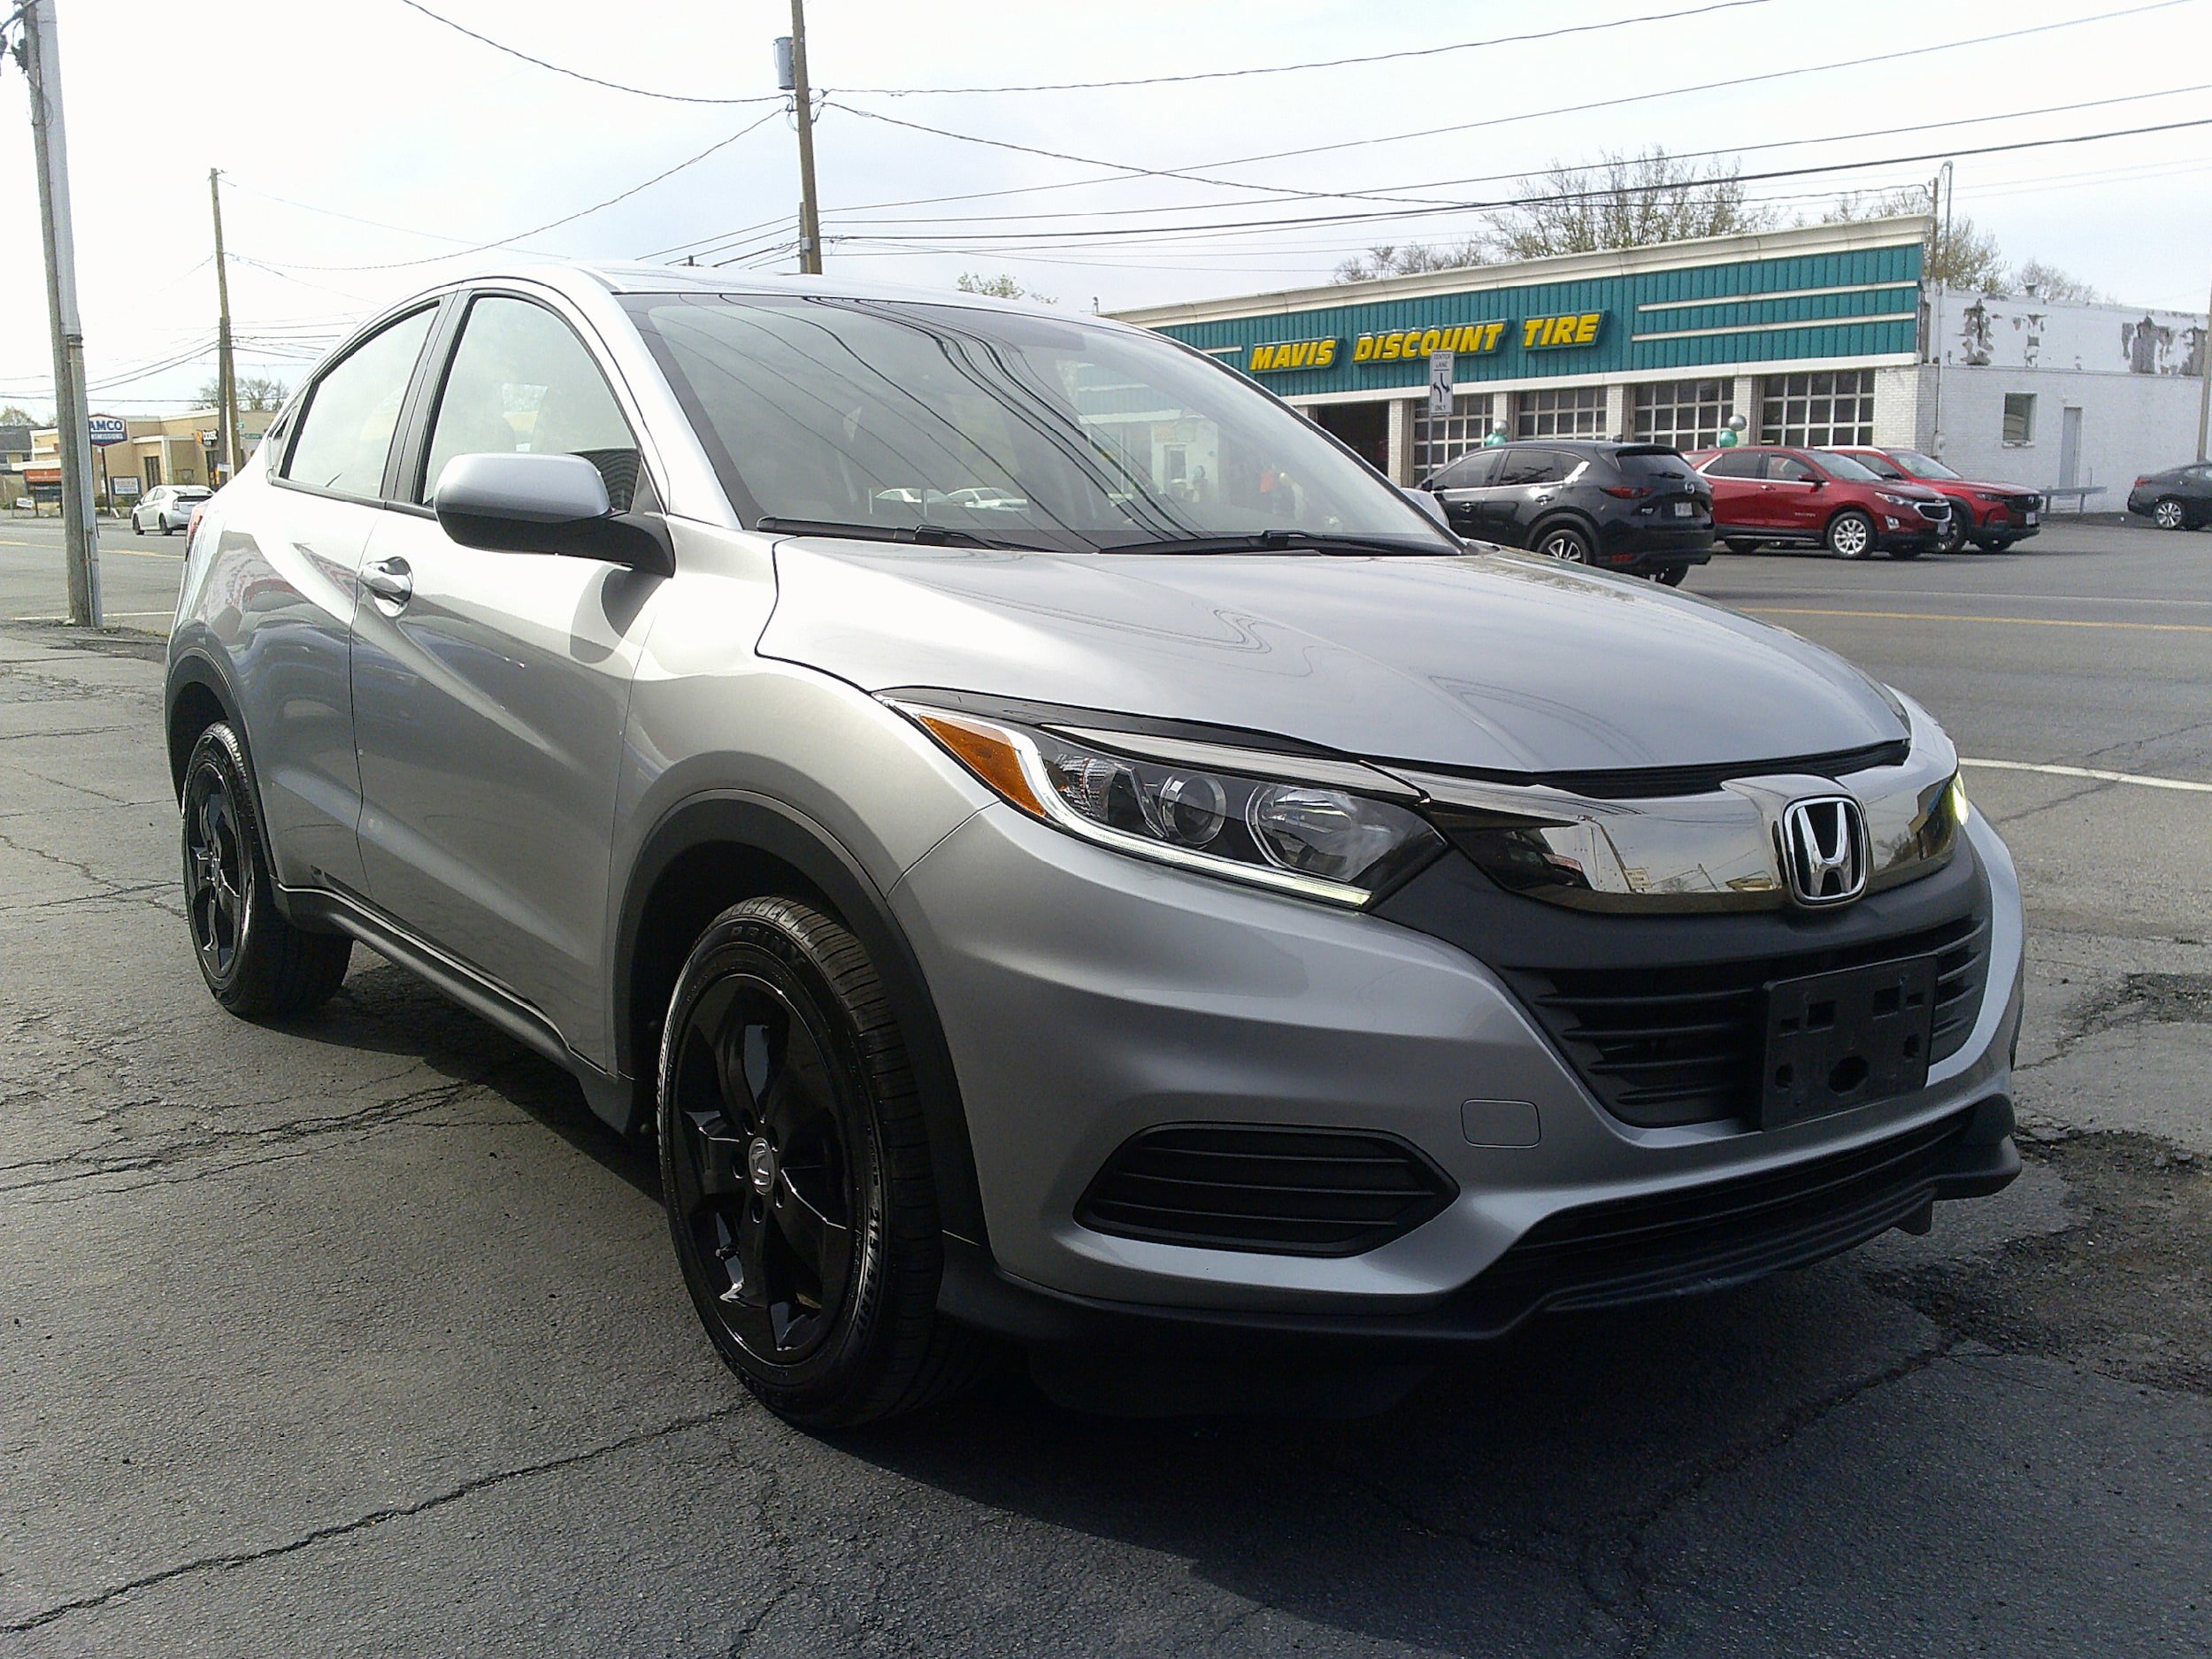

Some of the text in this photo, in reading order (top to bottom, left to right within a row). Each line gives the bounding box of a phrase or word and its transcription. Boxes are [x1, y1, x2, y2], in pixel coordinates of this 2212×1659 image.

[1250, 314, 1600, 371] MAVIS DISCOUNT TIRE
[89, 420, 123, 430] AMCO
